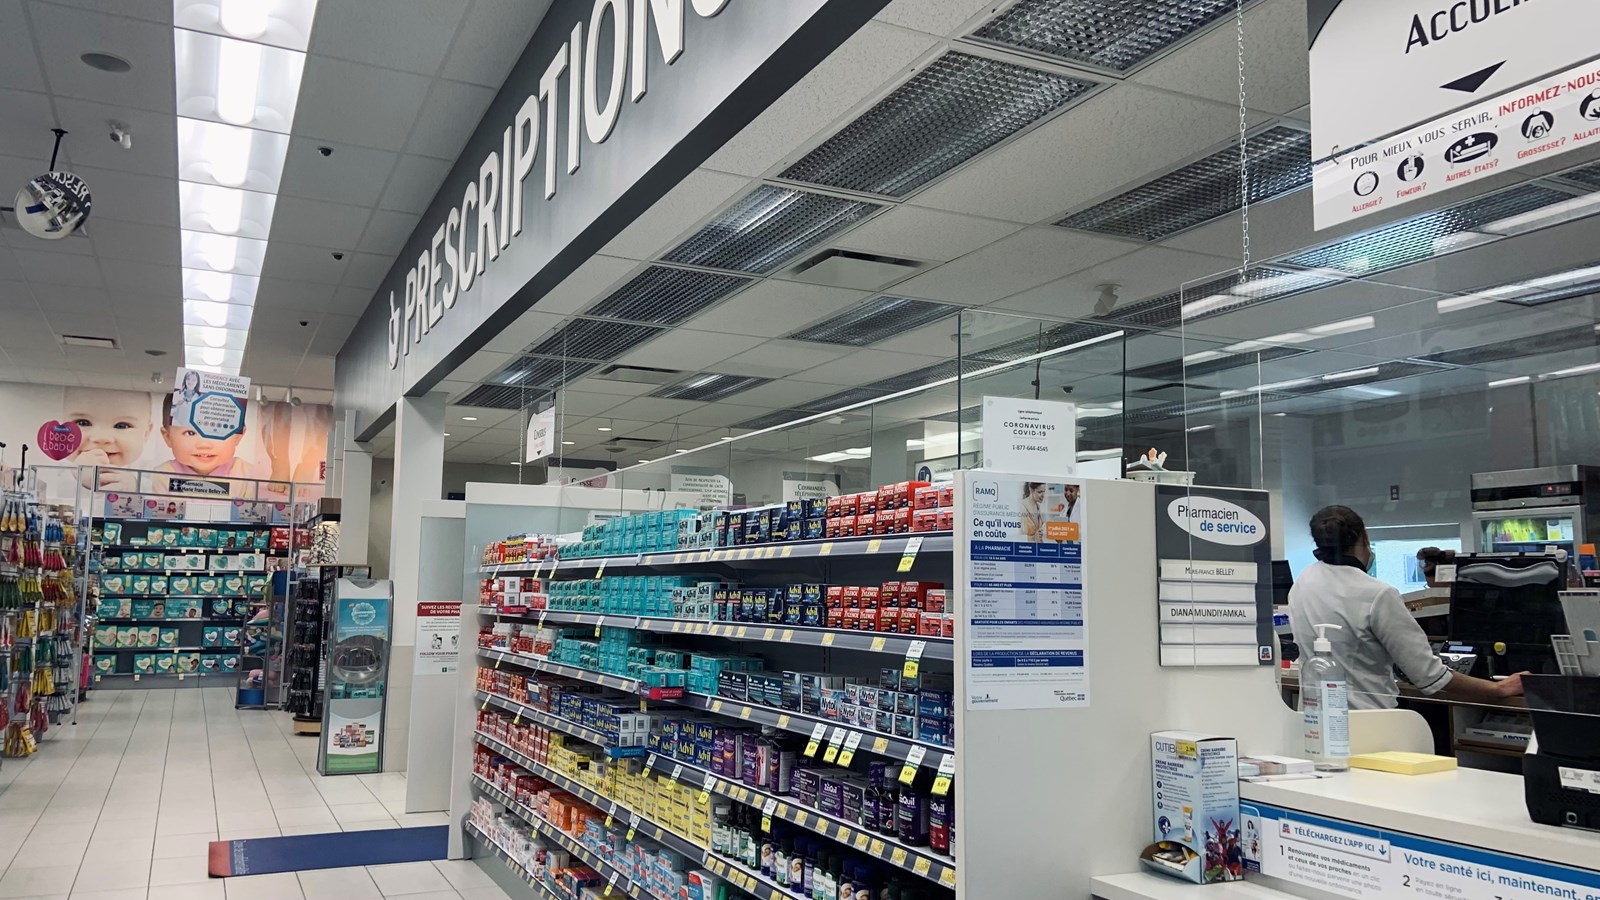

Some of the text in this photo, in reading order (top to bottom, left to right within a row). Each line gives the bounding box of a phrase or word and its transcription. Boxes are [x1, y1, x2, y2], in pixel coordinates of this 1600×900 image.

[1405, 0, 1529, 54] ACCUE
[1351, 152, 1378, 170] POUR
[1382, 141, 1412, 158] MIEUX
[1418, 127, 1446, 145] VOUS
[1352, 196, 1383, 213] ALLERGIE?
[1396, 182, 1427, 199] FUMEUR?
[1446, 169, 1471, 182] AUTRES
[1517, 137, 1566, 160] GROSSESSE?
[1573, 126, 1600, 142] ALLAIT
[1003, 421, 1055, 430] CORONAVIRUS
[1013, 429, 1047, 437] COVID-19
[1012, 444, 1049, 452] 1-877-644-4545
[797, 484, 827, 492] COMMANDES
[975, 487, 996, 496] RAMQ
[876, 513, 894, 521] TYLENOL
[1177, 504, 1239, 521] Pharmacien
[973, 518, 1021, 529] Ce qu'il vous
[1200, 520, 1257, 534] de service
[985, 529, 1007, 538] coûte
[1216, 567, 1235, 576] BELLEY
[1171, 608, 1247, 617] DIANA MUNDIYAMKAL
[862, 690, 876, 701] Nytol
[821, 697, 836, 711] Nytol
[843, 707, 856, 718] Nytol
[682, 723, 694, 733] Advil
[698, 729, 713, 740] Advil
[679, 742, 695, 756] Advil
[1156, 741, 1177, 754] CUTIB
[698, 751, 711, 762] Advil
[1294, 827, 1375, 852] TÉLÉCHARGEZ L'APP ICI
[1280, 845, 1284, 856] 1
[1287, 846, 1371, 872] Renouvelez vos médicaments
[1317, 862, 1328, 870] vos
[1328, 865, 1352, 876] proches
[1404, 852, 1436, 870] Votre
[1439, 861, 1473, 878] santé
[1476, 867, 1495, 884] ici,
[1402, 874, 1411, 888] 2
